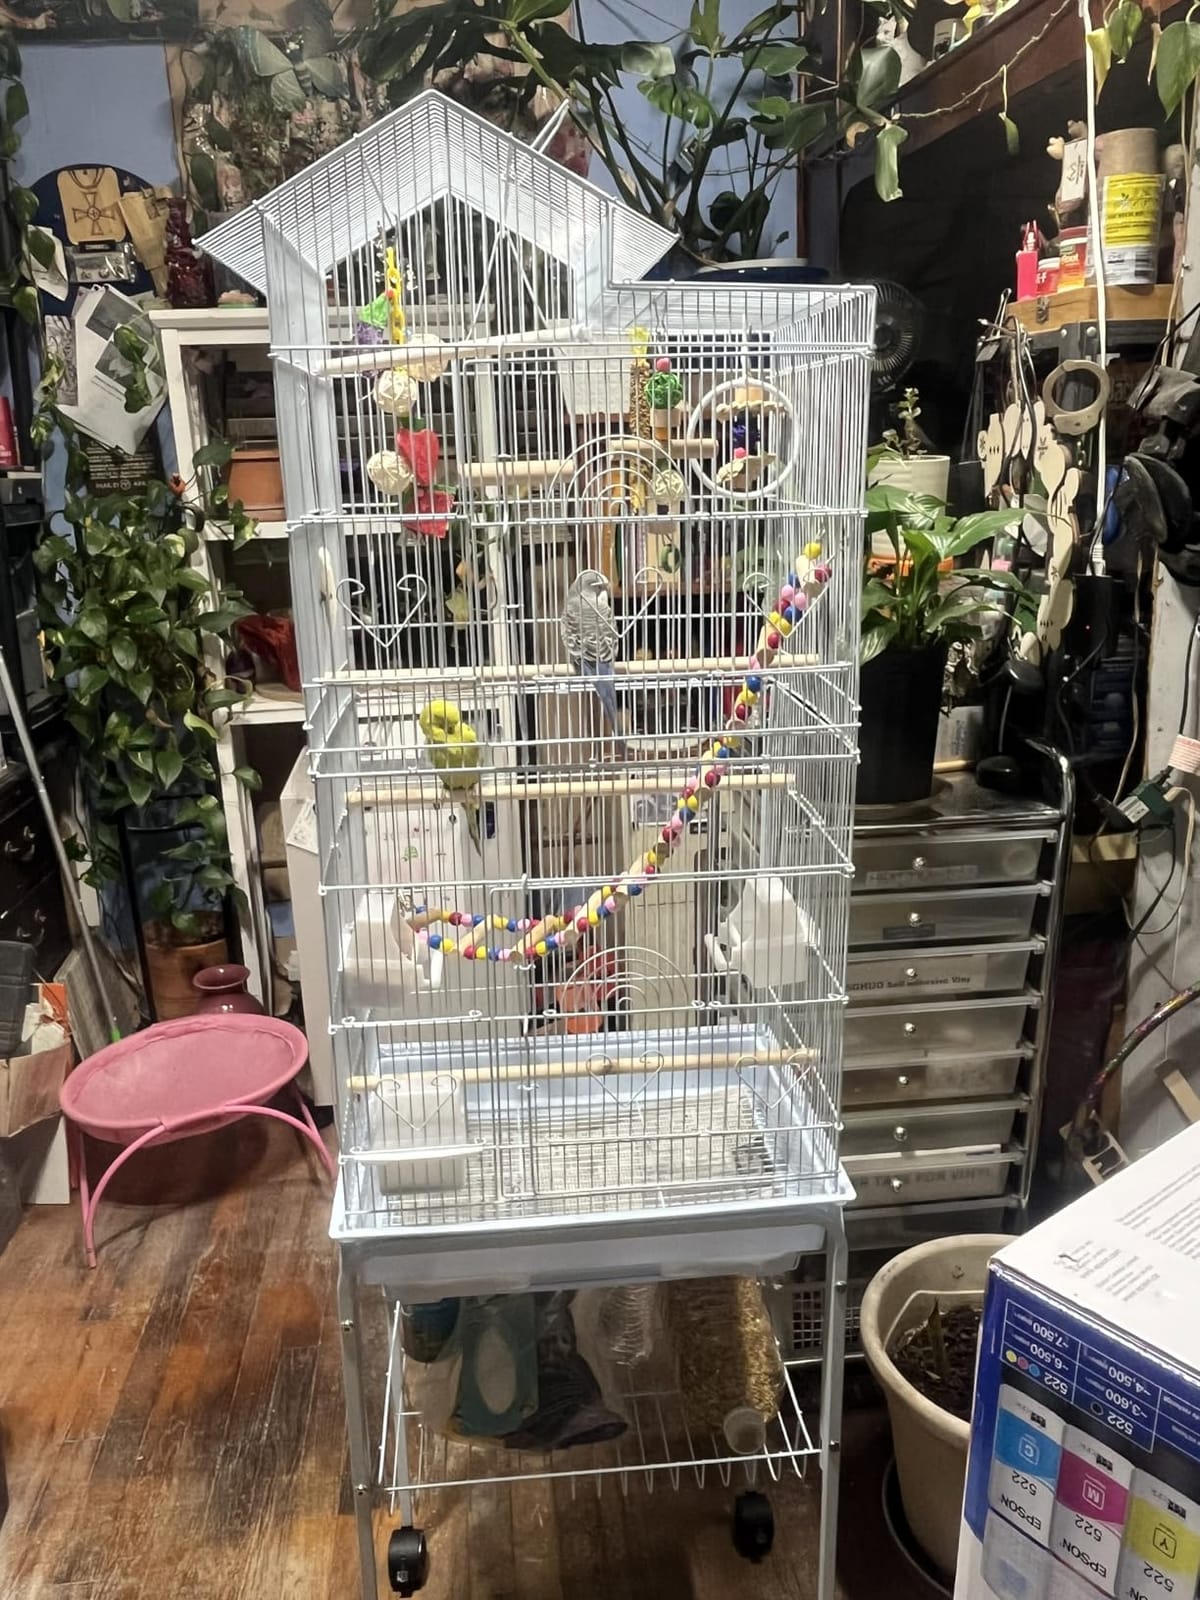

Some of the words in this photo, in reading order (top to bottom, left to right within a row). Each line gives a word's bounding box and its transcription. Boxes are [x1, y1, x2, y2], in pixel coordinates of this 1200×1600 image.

[1044, 1371, 1069, 1395] 522
[1107, 1411, 1134, 1436] 522
[1024, 1444, 1034, 1458] C
[1012, 1470, 1038, 1496] 522
[1086, 1486, 1100, 1504] M
[1000, 1493, 1042, 1531] EPSON
[1074, 1513, 1103, 1542] 522
[1159, 1538, 1169, 1551] Y
[1062, 1537, 1107, 1578] EPSON
[1143, 1561, 1175, 1593] 522
